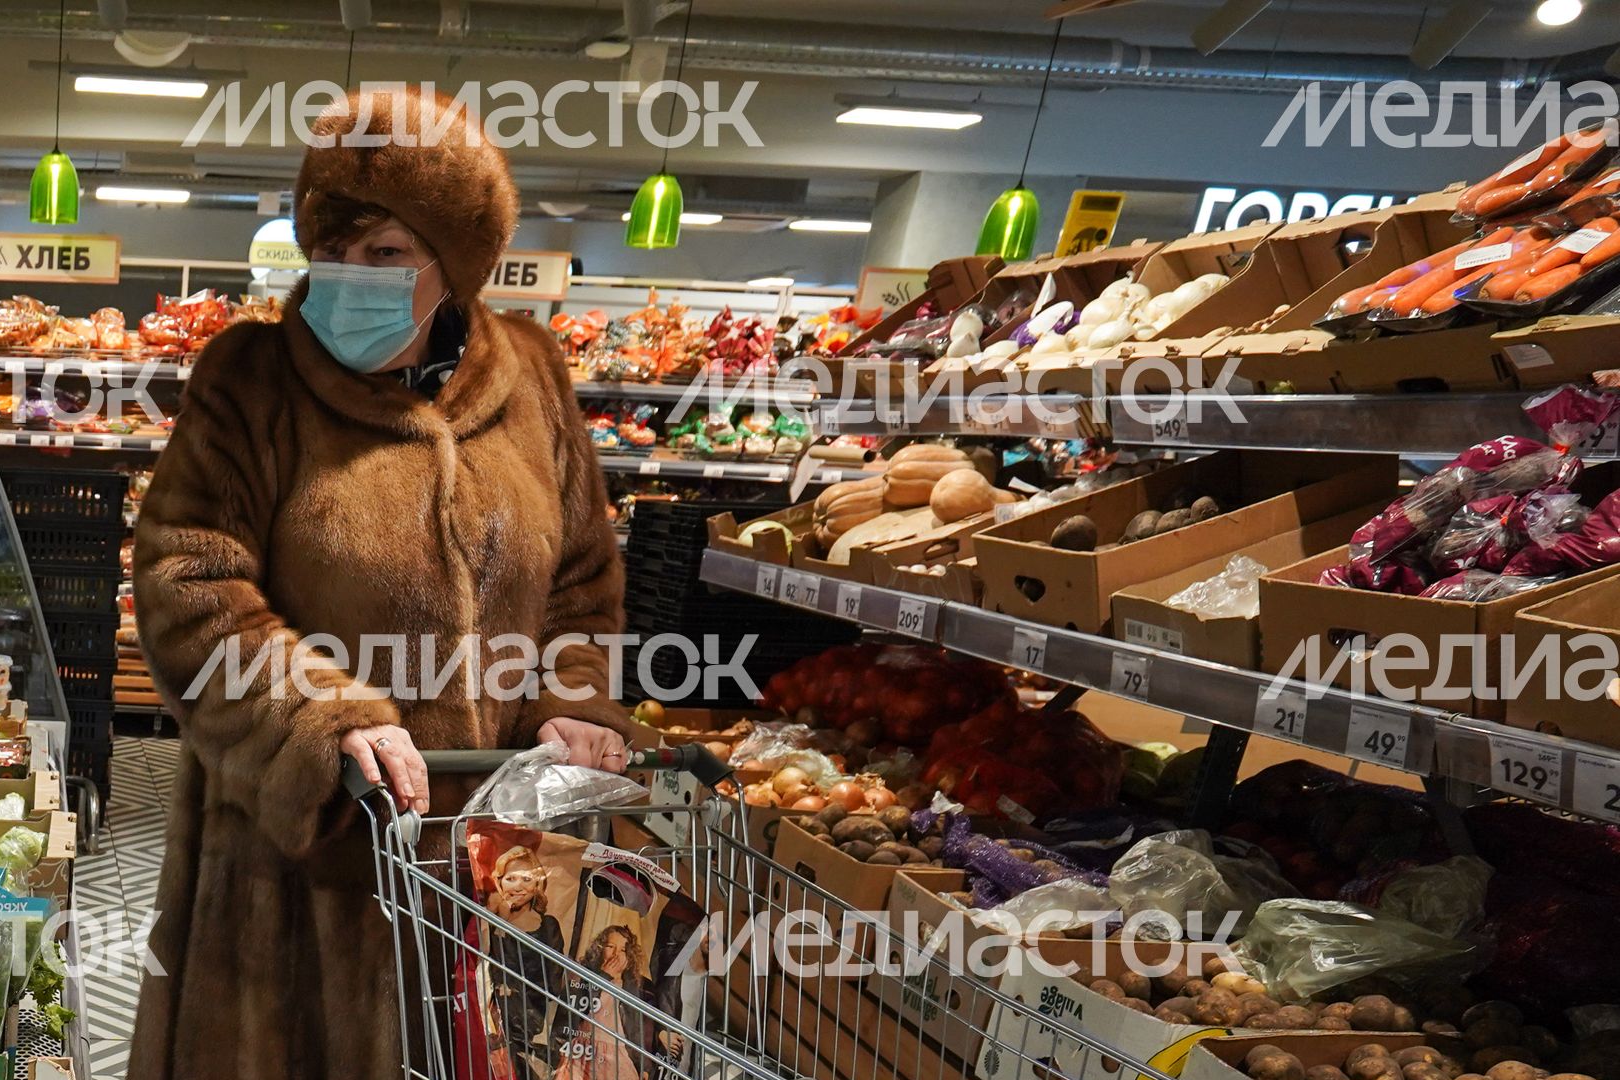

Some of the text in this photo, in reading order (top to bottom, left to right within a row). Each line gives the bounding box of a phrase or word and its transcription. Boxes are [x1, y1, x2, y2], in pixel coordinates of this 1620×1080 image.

[15, 244, 90, 271] ХЛЕБ
[494, 262, 538, 286] ЕБ
[1156, 419, 1181, 437] 549
[898, 611, 920, 629] 209
[1123, 670, 1142, 692] 79
[1273, 708, 1296, 733] 21
[1364, 730, 1396, 756] 49
[1500, 758, 1548, 790] 129
[569, 993, 602, 1014] 199
[1040, 985, 1083, 1021] Village
[559, 1041, 594, 1061] 499
